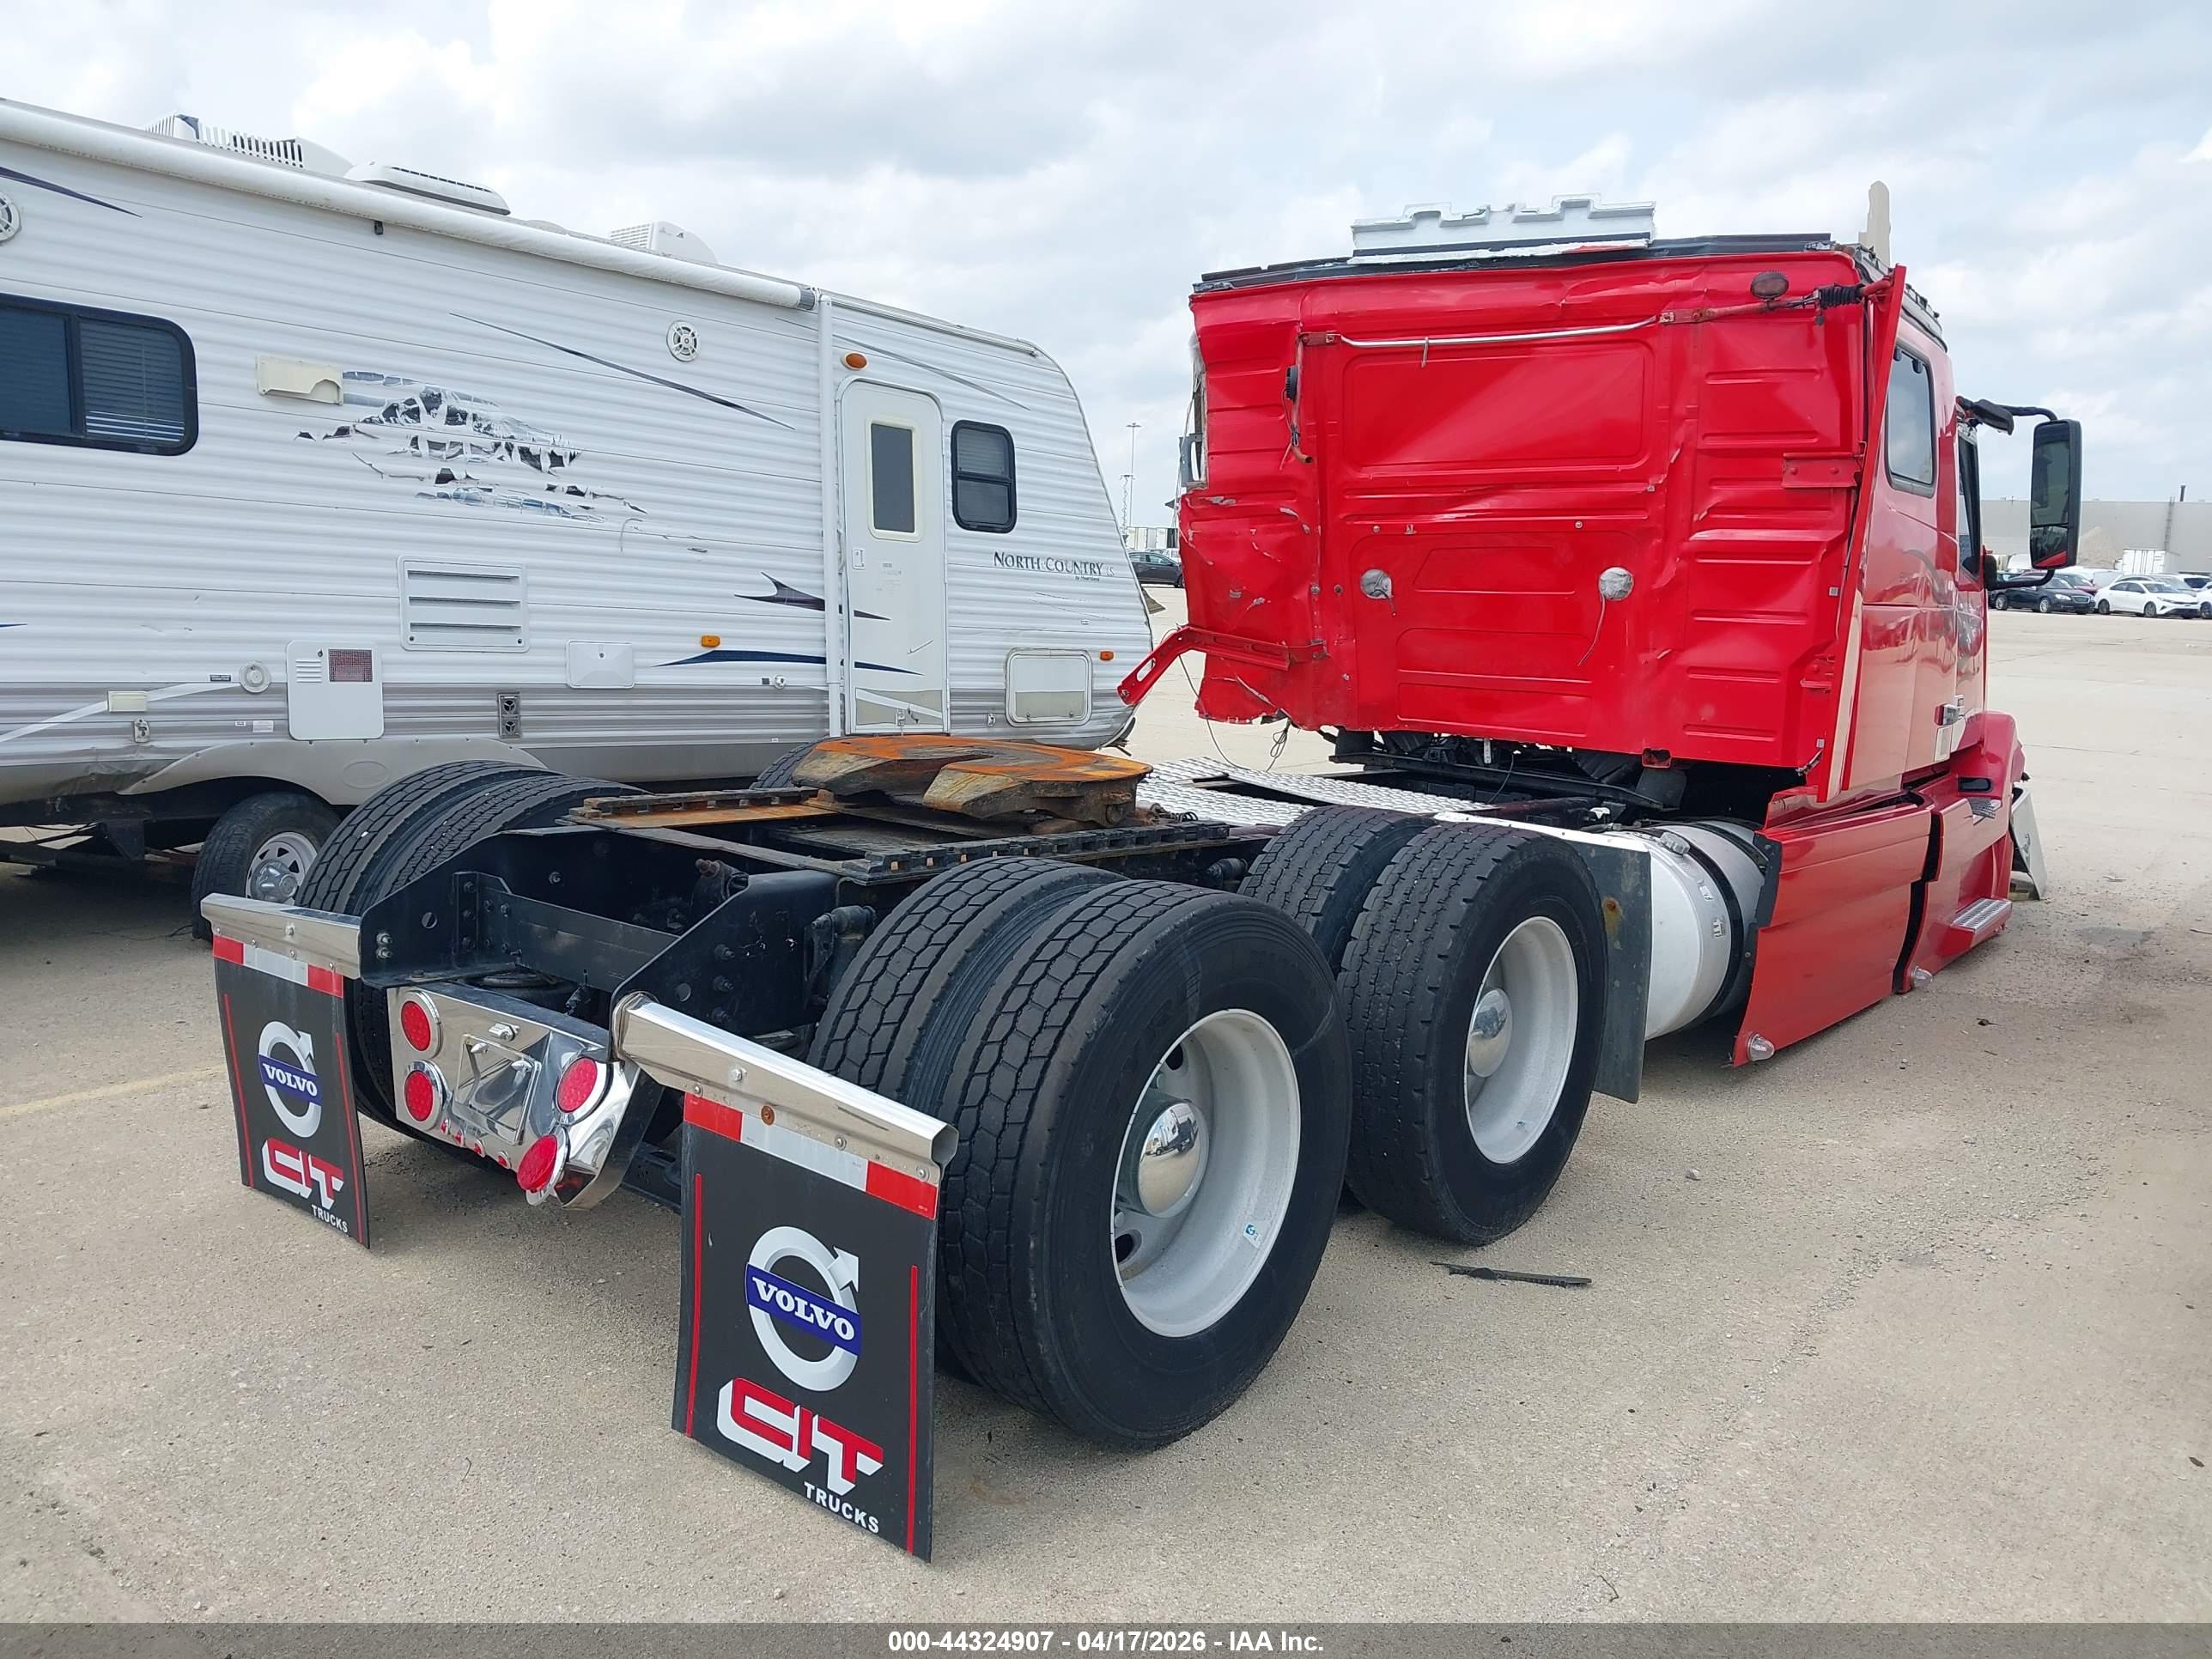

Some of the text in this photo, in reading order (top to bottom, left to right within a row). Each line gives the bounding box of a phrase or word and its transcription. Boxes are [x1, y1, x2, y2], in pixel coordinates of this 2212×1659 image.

[1045, 556, 1103, 575] COUNTRY
[262, 1062, 319, 1097] VOLVO
[311, 1204, 349, 1233] TRUCKS
[752, 1276, 855, 1341] VOLVO
[804, 1480, 879, 1534] TRUCKS
